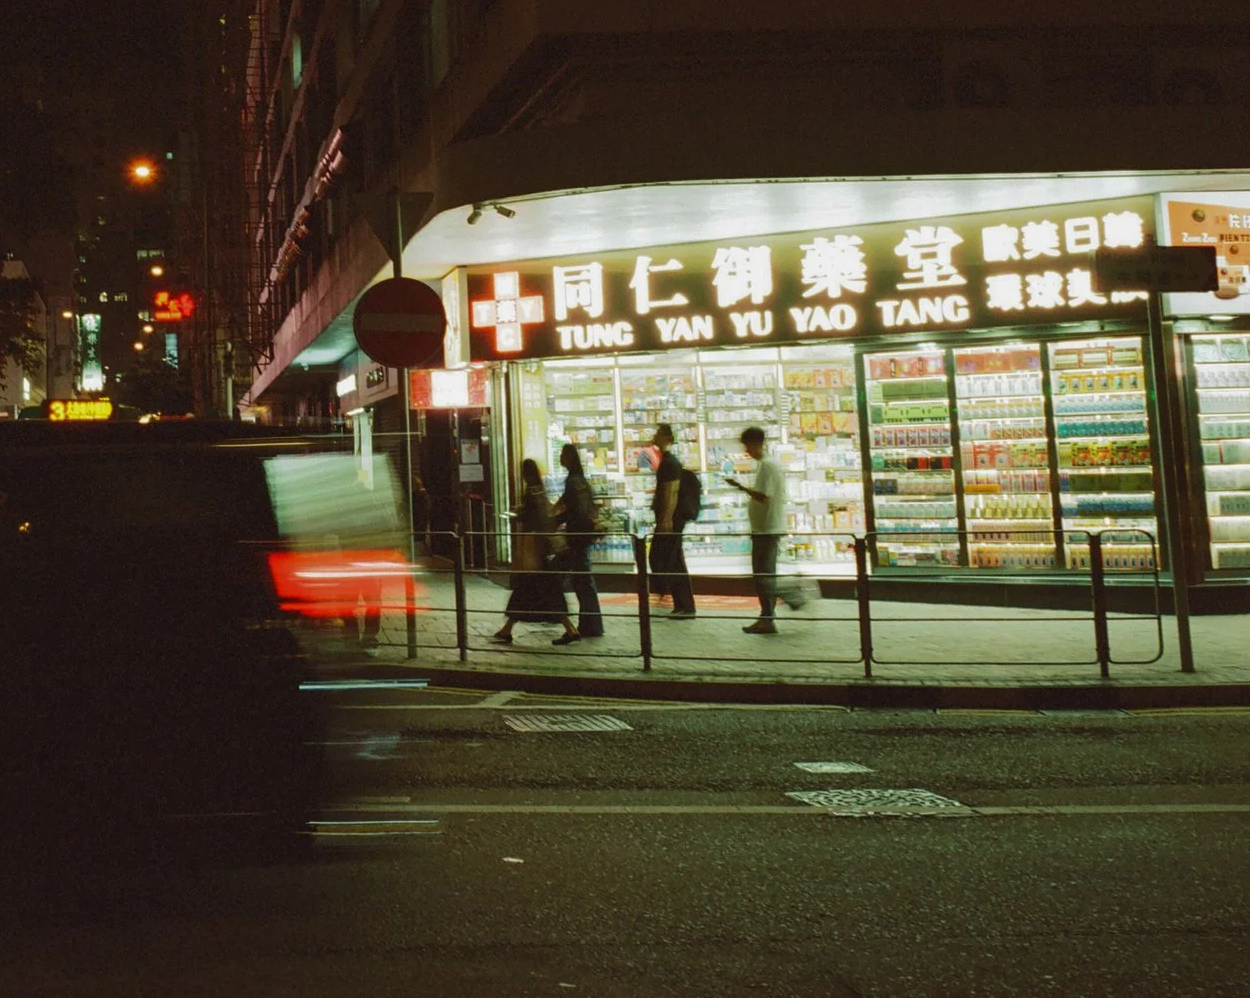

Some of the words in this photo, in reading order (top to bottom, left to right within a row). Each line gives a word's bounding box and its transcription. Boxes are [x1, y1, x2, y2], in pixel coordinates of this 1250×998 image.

[553, 225, 958, 321] 同仁御藥堂
[986, 267, 1150, 311] 環球美
[556, 321, 634, 351] TUNG
[655, 315, 714, 343] YAN
[729, 309, 773, 338] YU
[789, 303, 858, 334] YAO
[875, 294, 970, 327] TANG
[50, 400, 65, 421] 3
